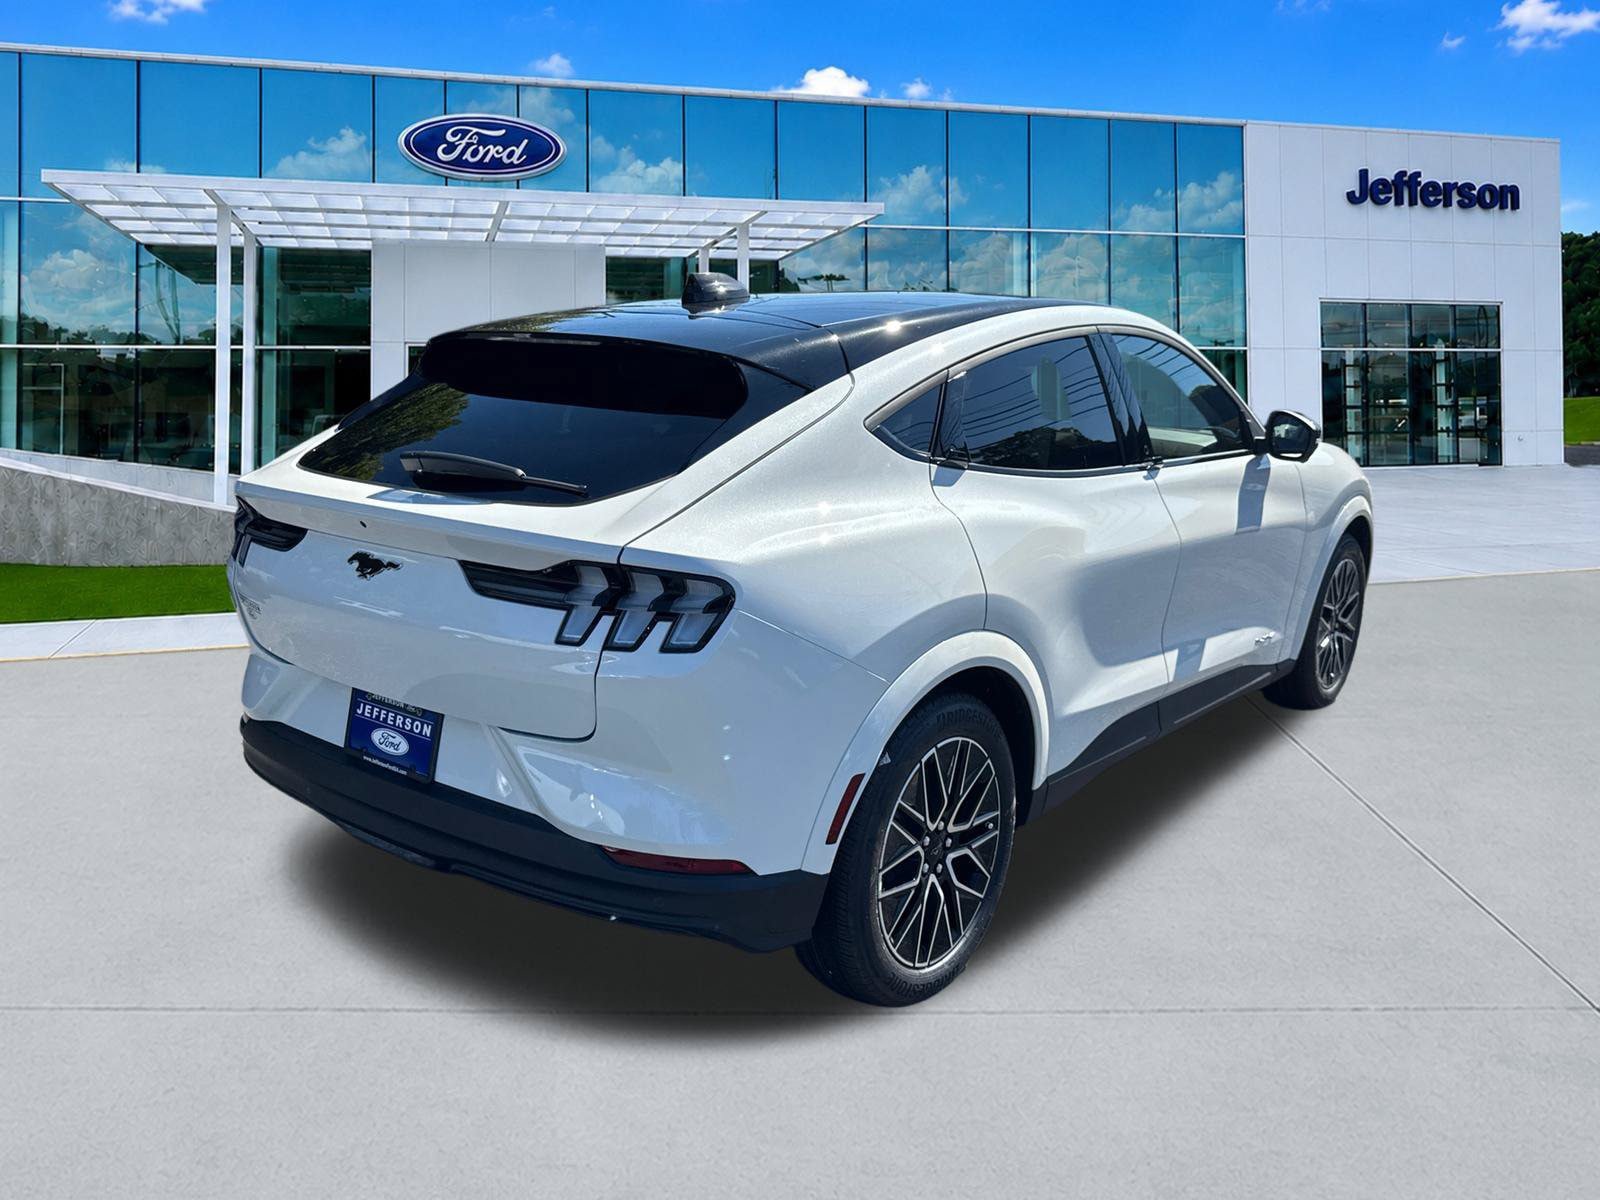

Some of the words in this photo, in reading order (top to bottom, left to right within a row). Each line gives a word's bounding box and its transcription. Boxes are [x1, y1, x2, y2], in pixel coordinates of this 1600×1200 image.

[436, 125, 529, 165] Ford
[1346, 168, 1521, 211] Jefferson
[356, 702, 432, 737] JEFFERSON
[378, 731, 402, 752] Ford
